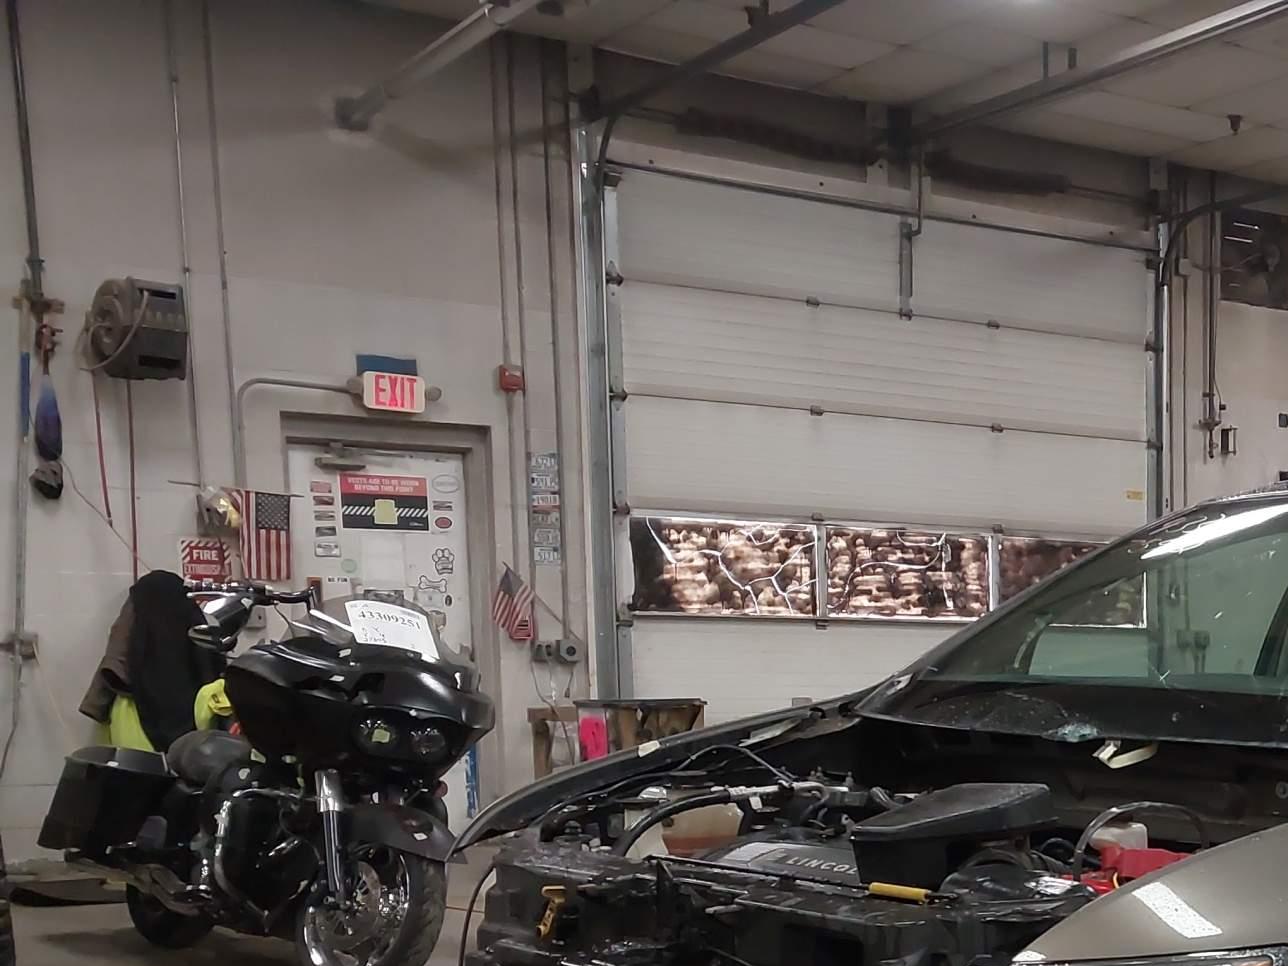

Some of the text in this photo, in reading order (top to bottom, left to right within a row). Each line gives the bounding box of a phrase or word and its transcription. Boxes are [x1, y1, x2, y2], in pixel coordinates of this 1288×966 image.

[374, 374, 417, 409] EXIT
[192, 549, 219, 561] FIRE
[358, 609, 421, 630] 43309251
[785, 856, 858, 875] LINCOL
